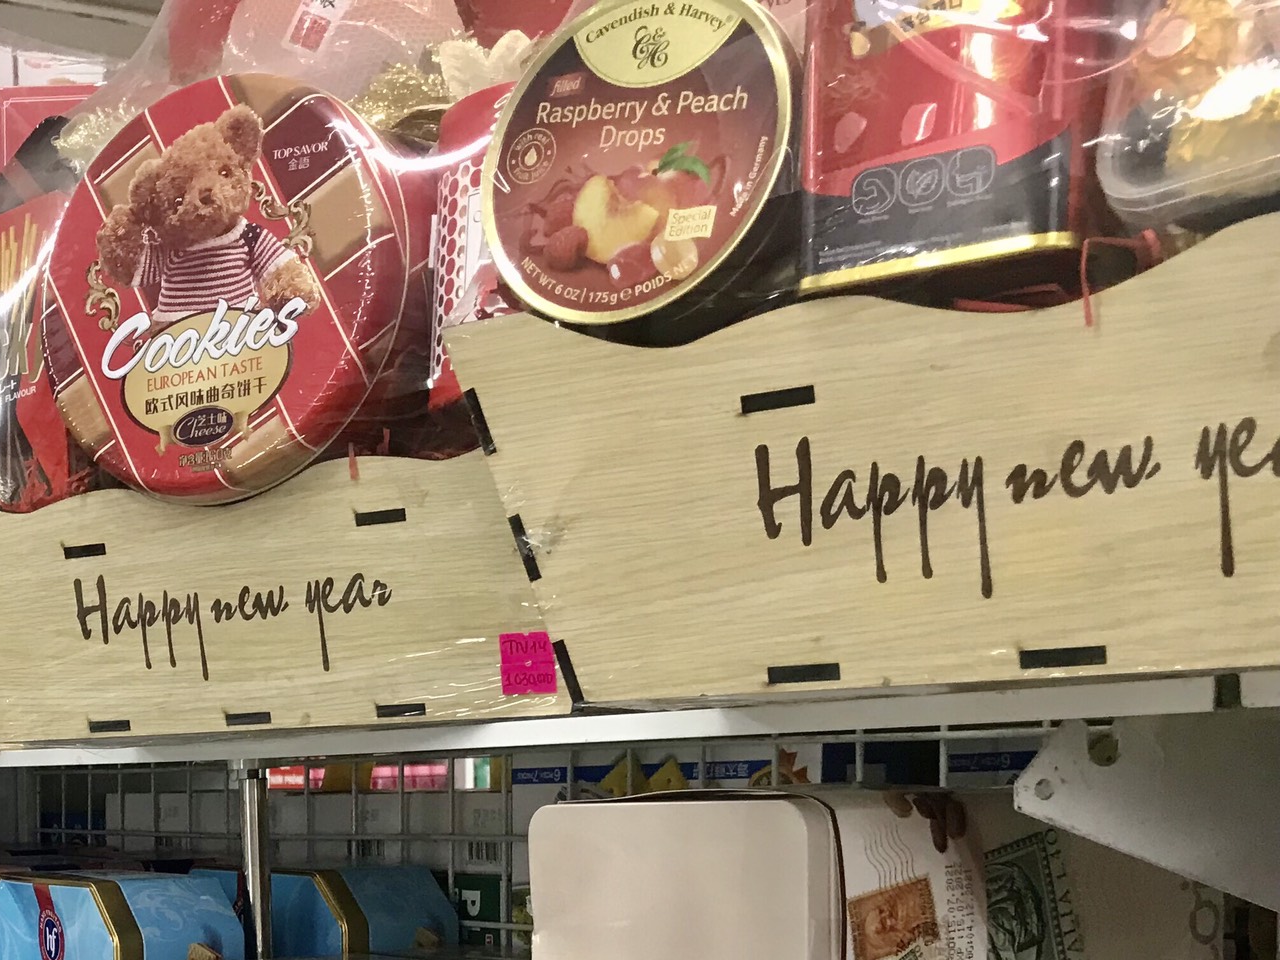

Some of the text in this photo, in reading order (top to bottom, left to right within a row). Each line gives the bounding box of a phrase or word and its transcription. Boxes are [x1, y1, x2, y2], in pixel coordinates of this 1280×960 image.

[585, 1, 726, 44] Cavendish & Harvey
[550, 76, 582, 95] filled
[536, 85, 748, 127] Raspberry & Peach
[272, 141, 328, 159] TOP SAVOR
[599, 125, 667, 151] Drops
[748, 136, 769, 181] Germany
[668, 223, 709, 237] Edition
[671, 208, 711, 223] Special
[521, 257, 539, 278] NET
[538, 271, 554, 290] WT
[555, 284, 563, 294] 6
[563, 286, 580, 300] OZ
[634, 273, 672, 297] POIDS
[101, 296, 307, 380] Cookies
[147, 356, 263, 392] EUROPEAN TASTE
[5, 386, 37, 402] FLAVOUR
[145, 377, 267, 415] 欧式风味曲奇饼干
[176, 417, 227, 440] Cheese
[196, 411, 228, 426] 芝士味
[755, 436, 993, 598] Happy
[1006, 436, 1161, 504] new
[73, 572, 392, 680] Happy new year
